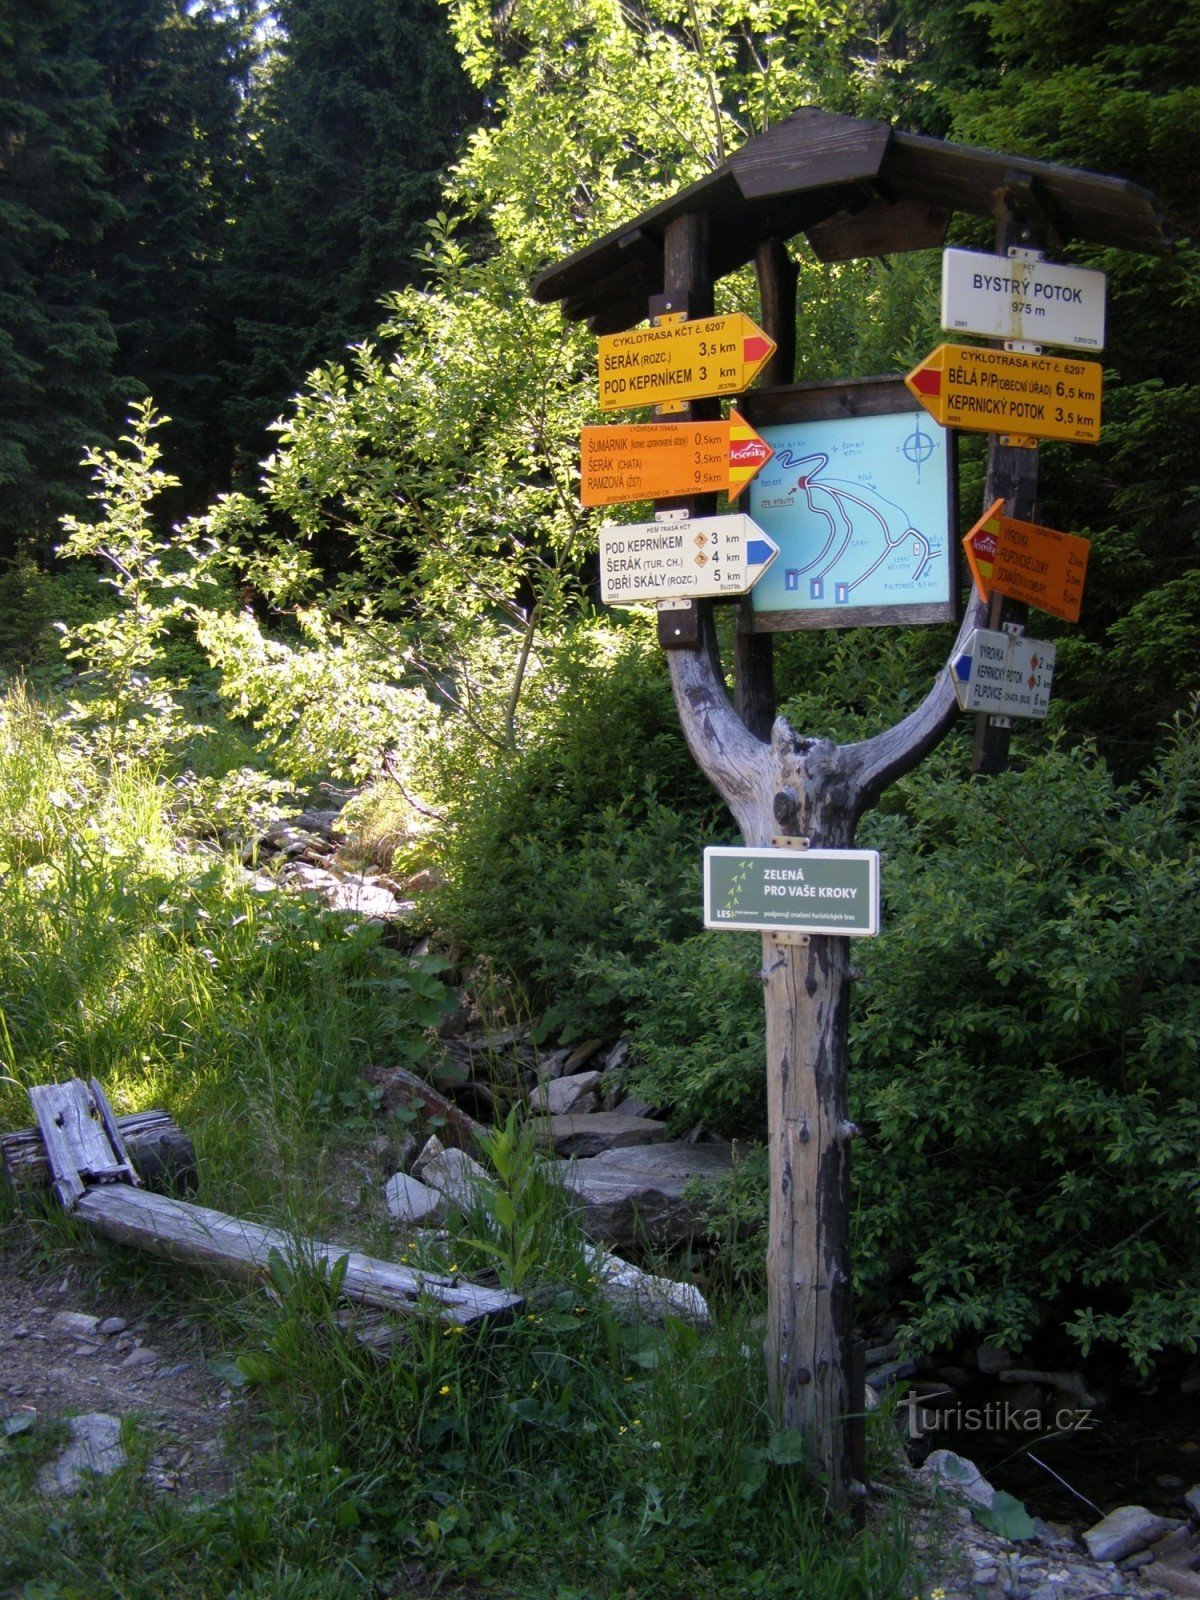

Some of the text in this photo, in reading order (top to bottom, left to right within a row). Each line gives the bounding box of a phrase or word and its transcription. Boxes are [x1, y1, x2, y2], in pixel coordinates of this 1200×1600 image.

[974, 274, 1082, 304] BYSTRÝ POTOK
[1012, 302, 1045, 316] 975 m
[613, 322, 726, 348] CYKLOTRASA KČT č. 6207
[604, 342, 736, 371] ŠERÁK (ROZC.) 3,5 km
[961, 351, 1085, 376] CYKLOTRASA KČT č. 6207
[604, 367, 736, 394] POD KEPRNÍKEM 3 km
[948, 366, 977, 386] BĚLÁ
[1029, 380, 1051, 397] ÚŘAD)
[1056, 382, 1074, 398] 6,5
[1078, 389, 1095, 400] km
[947, 394, 1094, 426] KEPRNICKÝ POTOK 3,5 km
[588, 457, 613, 472] ŠERÁK
[617, 458, 642, 471] (CHATA)
[588, 474, 624, 489] RAMZOVÁ
[626, 477, 641, 489] (ŽST)
[605, 532, 739, 554] POD KEPRNÍKEM 3 km
[606, 551, 740, 572] ŠERÁK (TUR. CH.) 4 km
[607, 569, 740, 591] OBŘÍ SKÁLY (ROZC.) 5 km
[1039, 657, 1044, 669] 2
[1046, 662, 1053, 670] km
[1006, 669, 1023, 684] POTOK
[1036, 675, 1041, 687] 3
[1043, 680, 1051, 688] km
[1034, 694, 1039, 705] 6
[764, 868, 804, 881] ZELENÁ
[764, 884, 857, 899] PRO VAŠE KROKY
[764, 911, 790, 920] podporují
[812, 912, 843, 921] turistických
